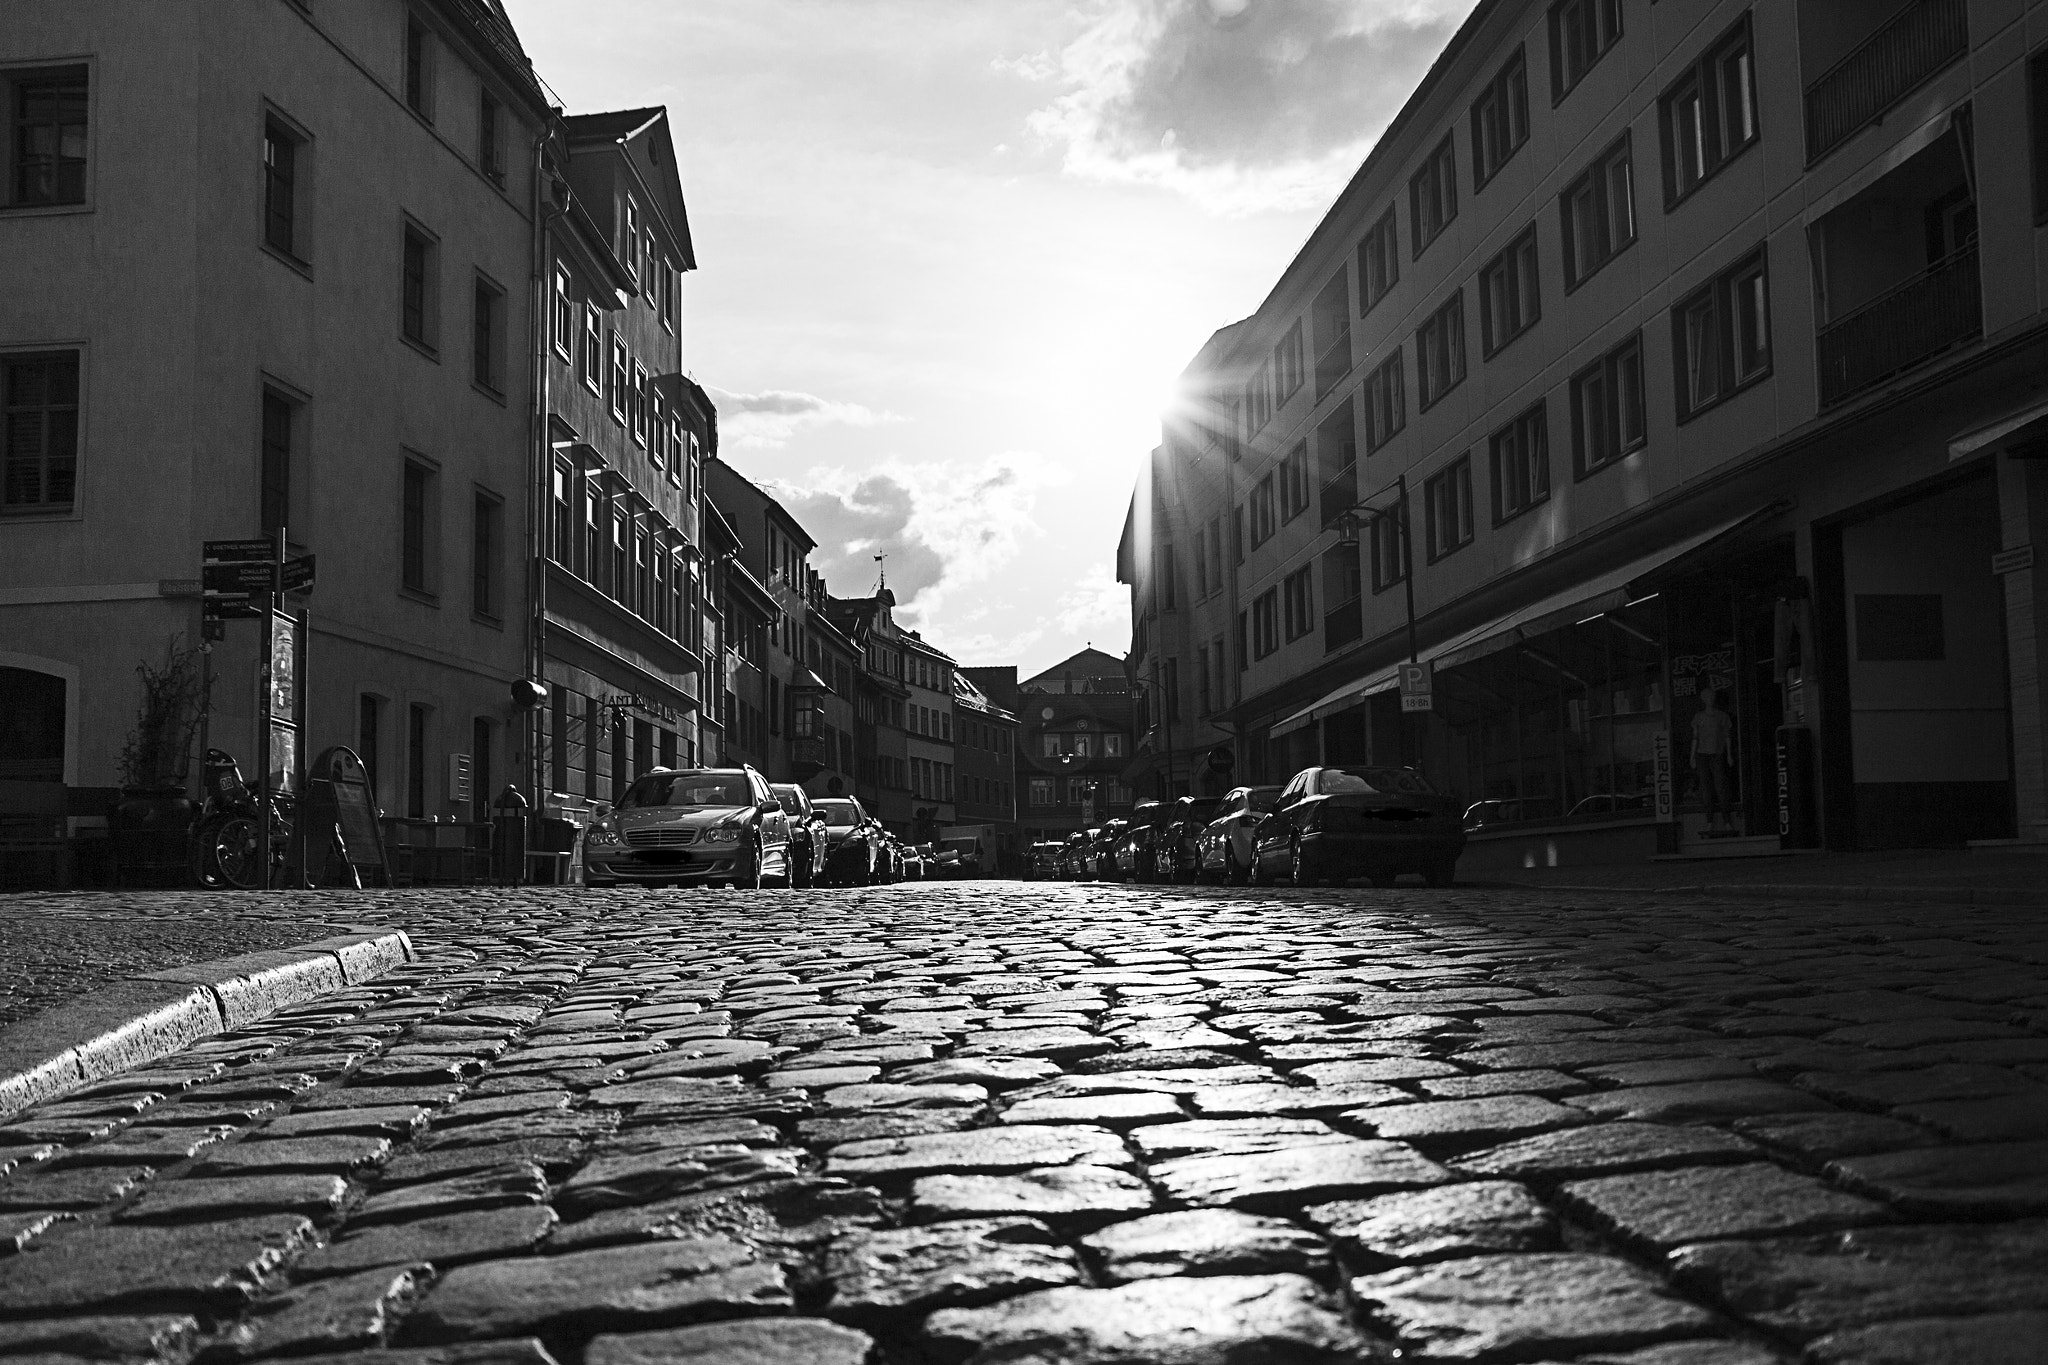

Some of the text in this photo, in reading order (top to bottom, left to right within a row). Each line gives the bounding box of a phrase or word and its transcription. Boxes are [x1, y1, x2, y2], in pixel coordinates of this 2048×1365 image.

[1673, 651, 1731, 676] FOX
[1407, 667, 1423, 691] P
[1673, 677, 1696, 687] NEW
[1674, 687, 1697, 697] ERA
[1655, 735, 1670, 815] carhartt
[1776, 742, 1789, 835] carhartt
